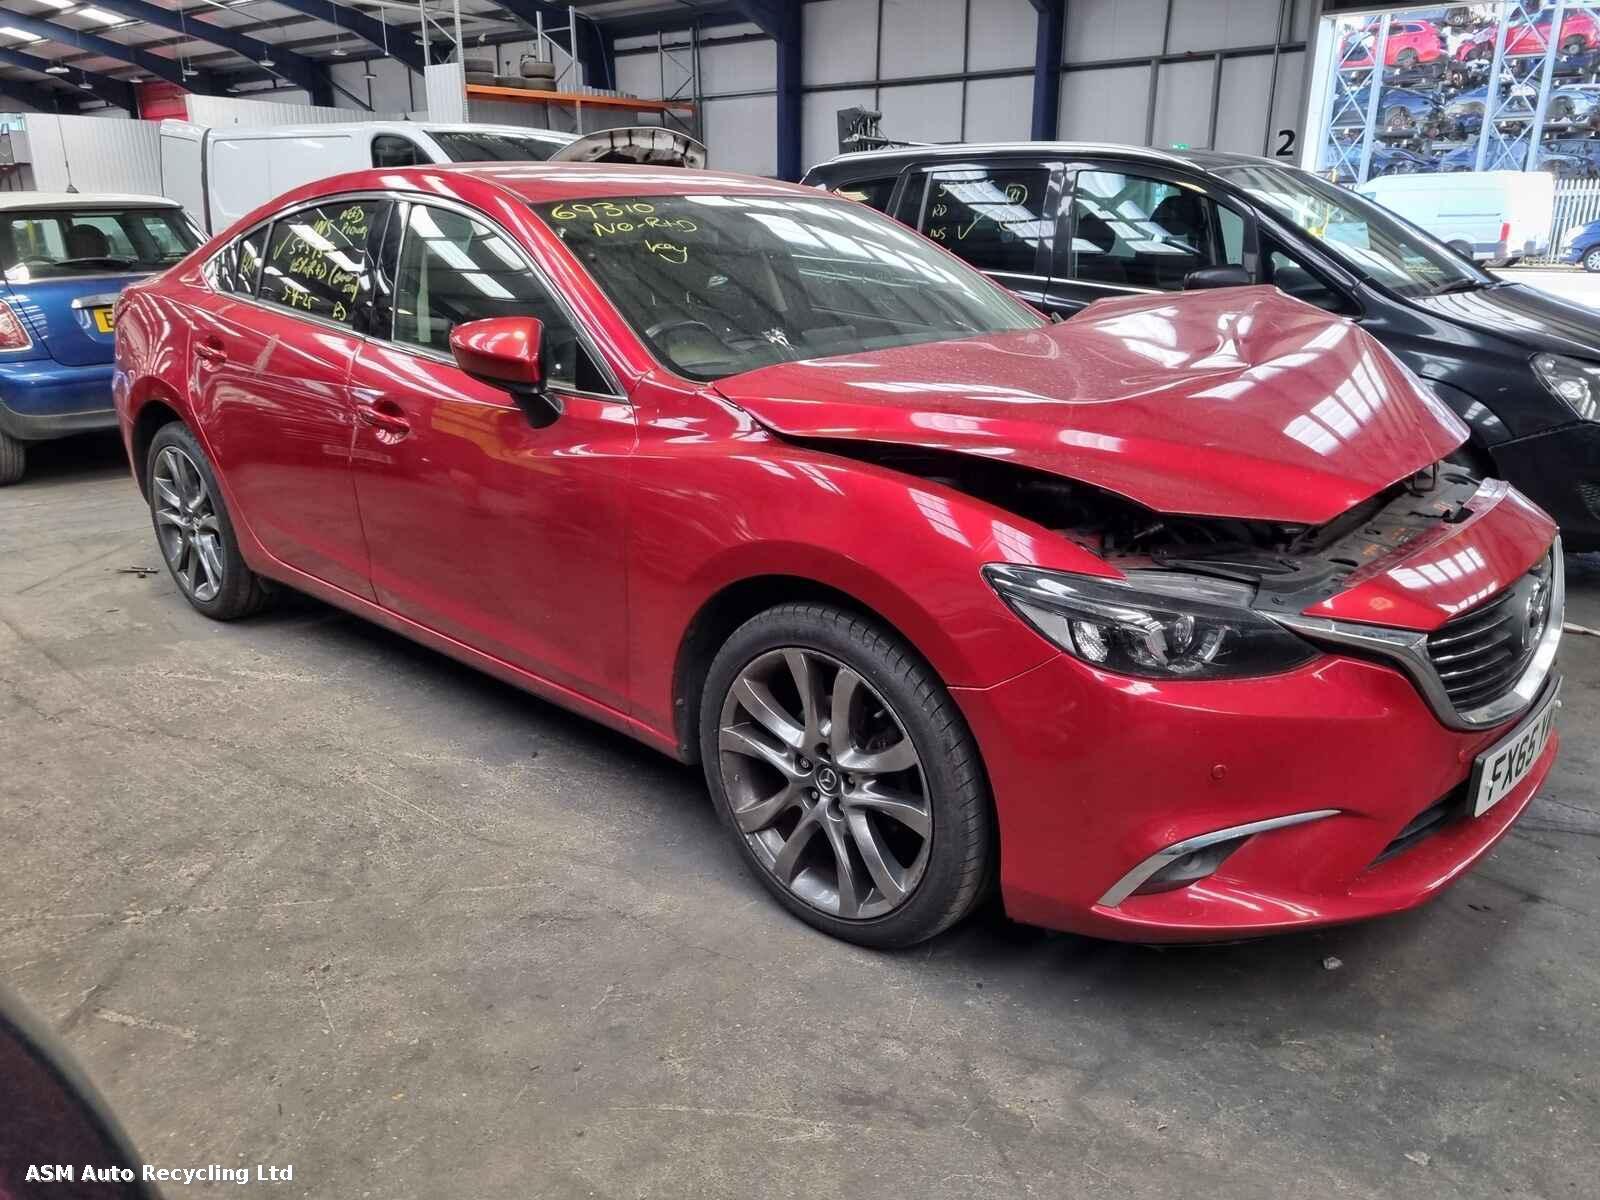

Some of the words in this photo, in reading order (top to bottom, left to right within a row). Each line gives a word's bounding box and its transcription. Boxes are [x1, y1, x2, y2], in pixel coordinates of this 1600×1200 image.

[1276, 130, 1296, 156] 2
[551, 203, 655, 220] 69310
[1487, 723, 1540, 802] FX65
